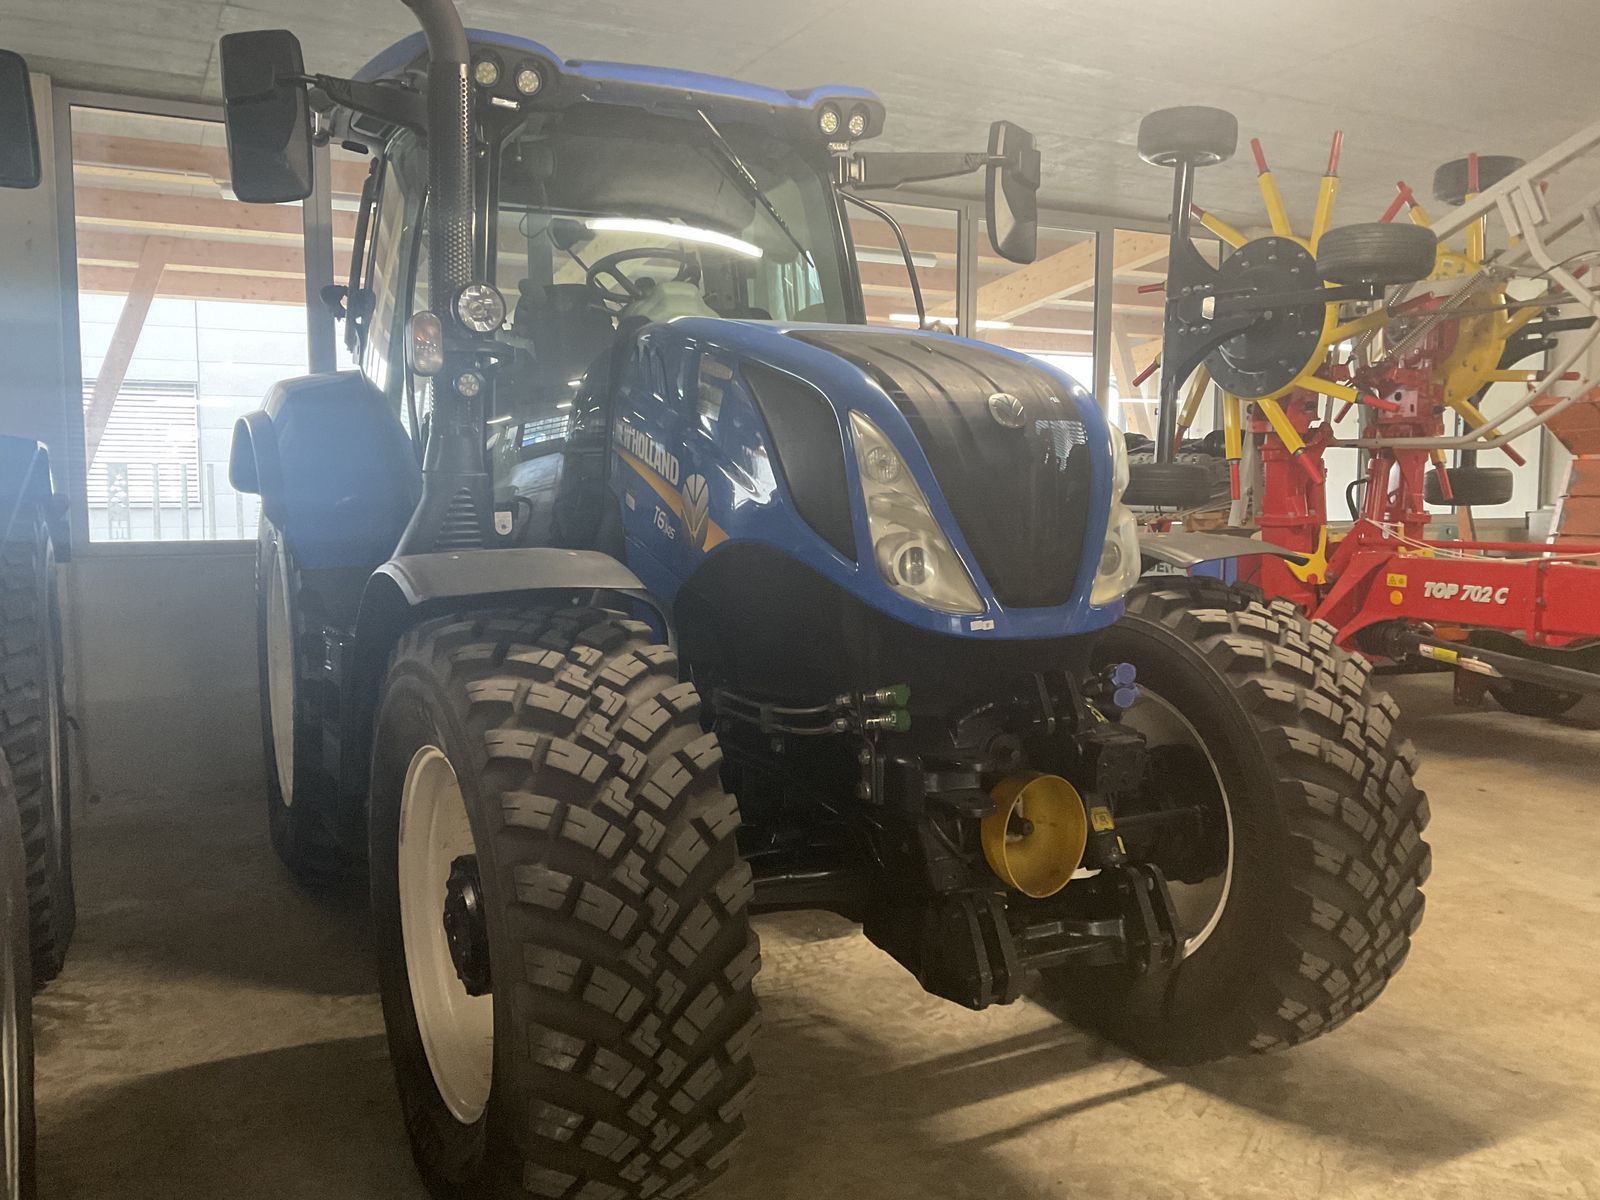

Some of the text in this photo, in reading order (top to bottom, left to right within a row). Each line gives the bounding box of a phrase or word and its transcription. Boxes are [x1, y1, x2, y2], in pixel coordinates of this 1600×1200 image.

[632, 428, 679, 486] HOLLAND
[1423, 581, 1510, 605] TOP 702 C
